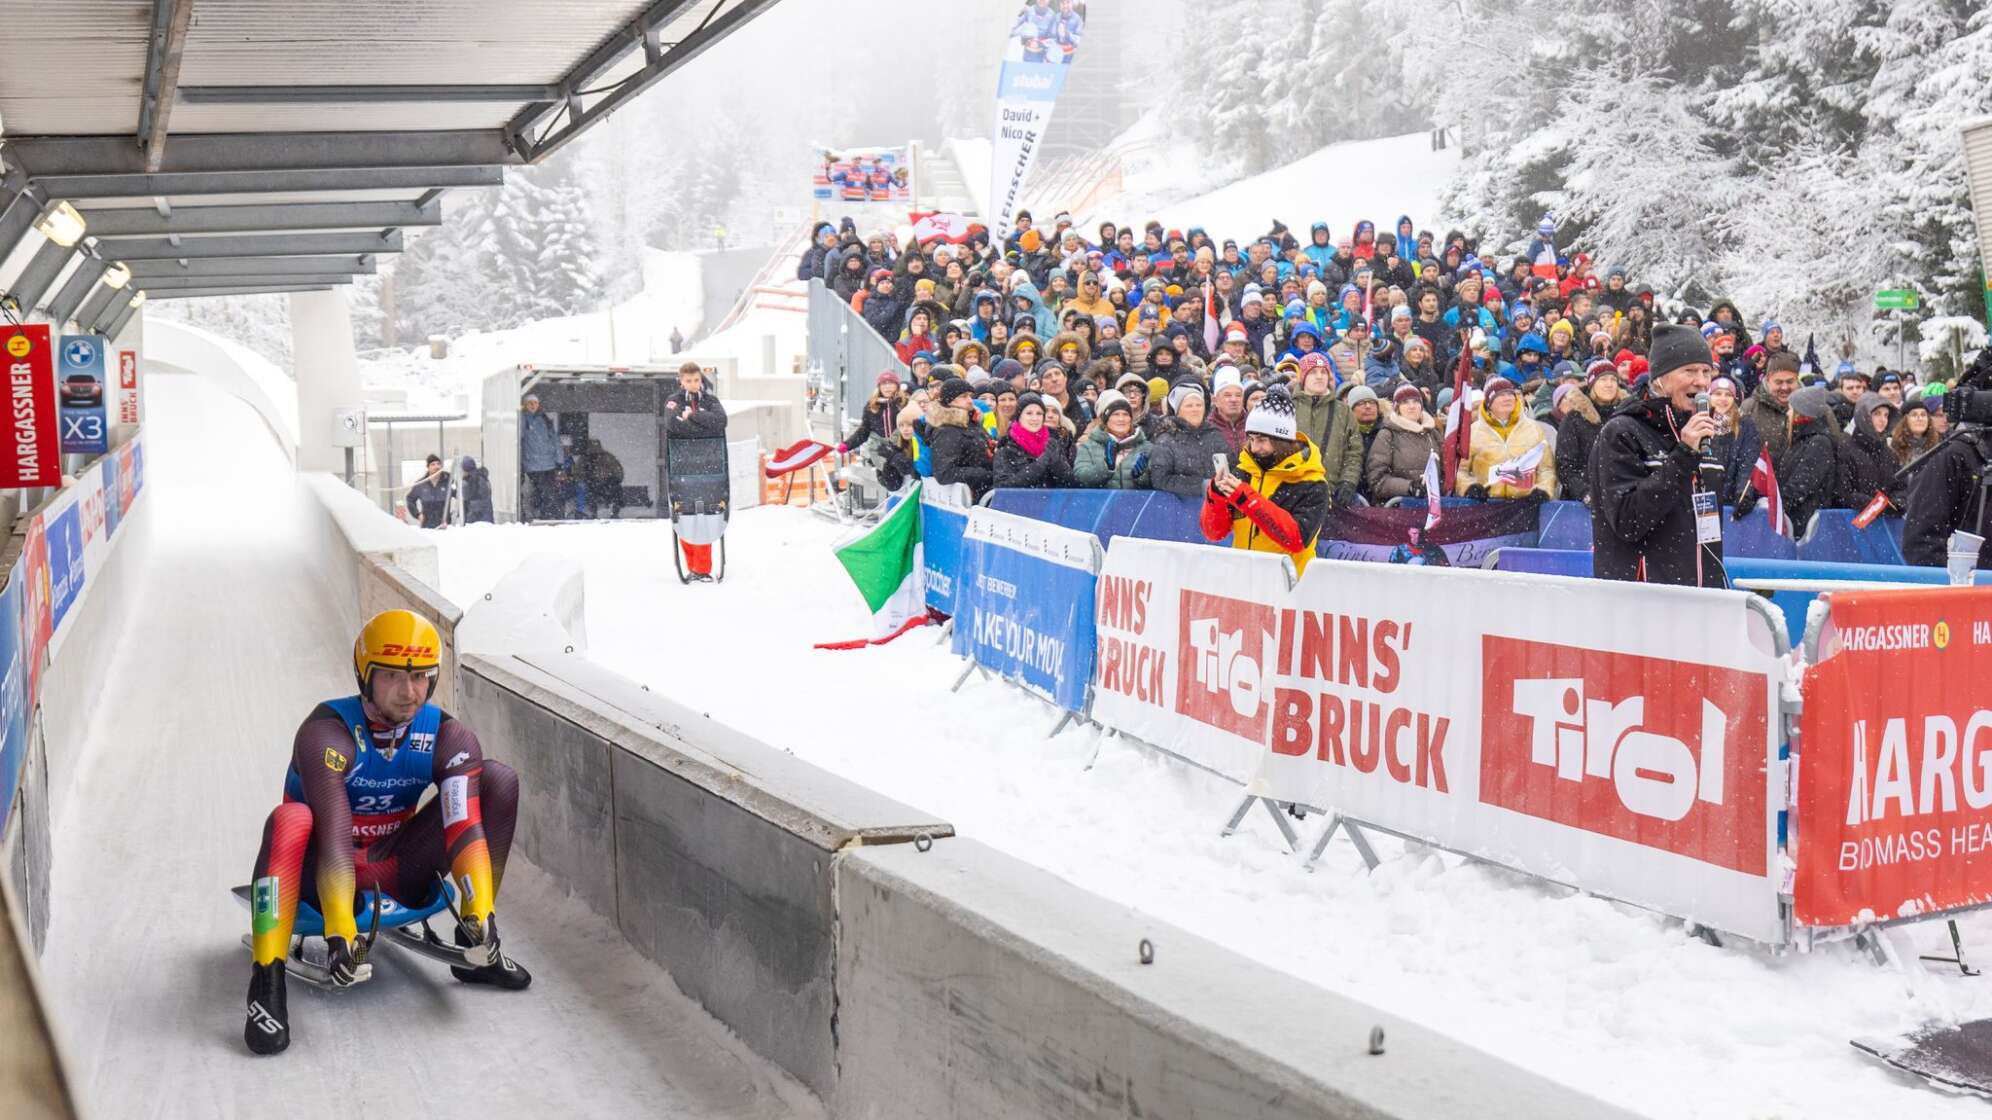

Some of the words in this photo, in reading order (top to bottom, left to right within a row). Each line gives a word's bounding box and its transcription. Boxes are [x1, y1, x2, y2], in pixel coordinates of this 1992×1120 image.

[1002, 108, 1032, 122] David
[1001, 126, 1023, 140] Nico
[10, 362, 40, 482] HARGASSNER
[64, 415, 103, 440] X3
[1973, 621, 1992, 644] HA
[382, 644, 434, 658] DHL
[1277, 608, 1412, 694] INNS'
[1271, 687, 1450, 794] BRUCK
[1513, 677, 1727, 822] Tirol
[355, 794, 395, 812] 23
[1951, 822, 1992, 855] HEA
[248, 999, 285, 1035] STS
